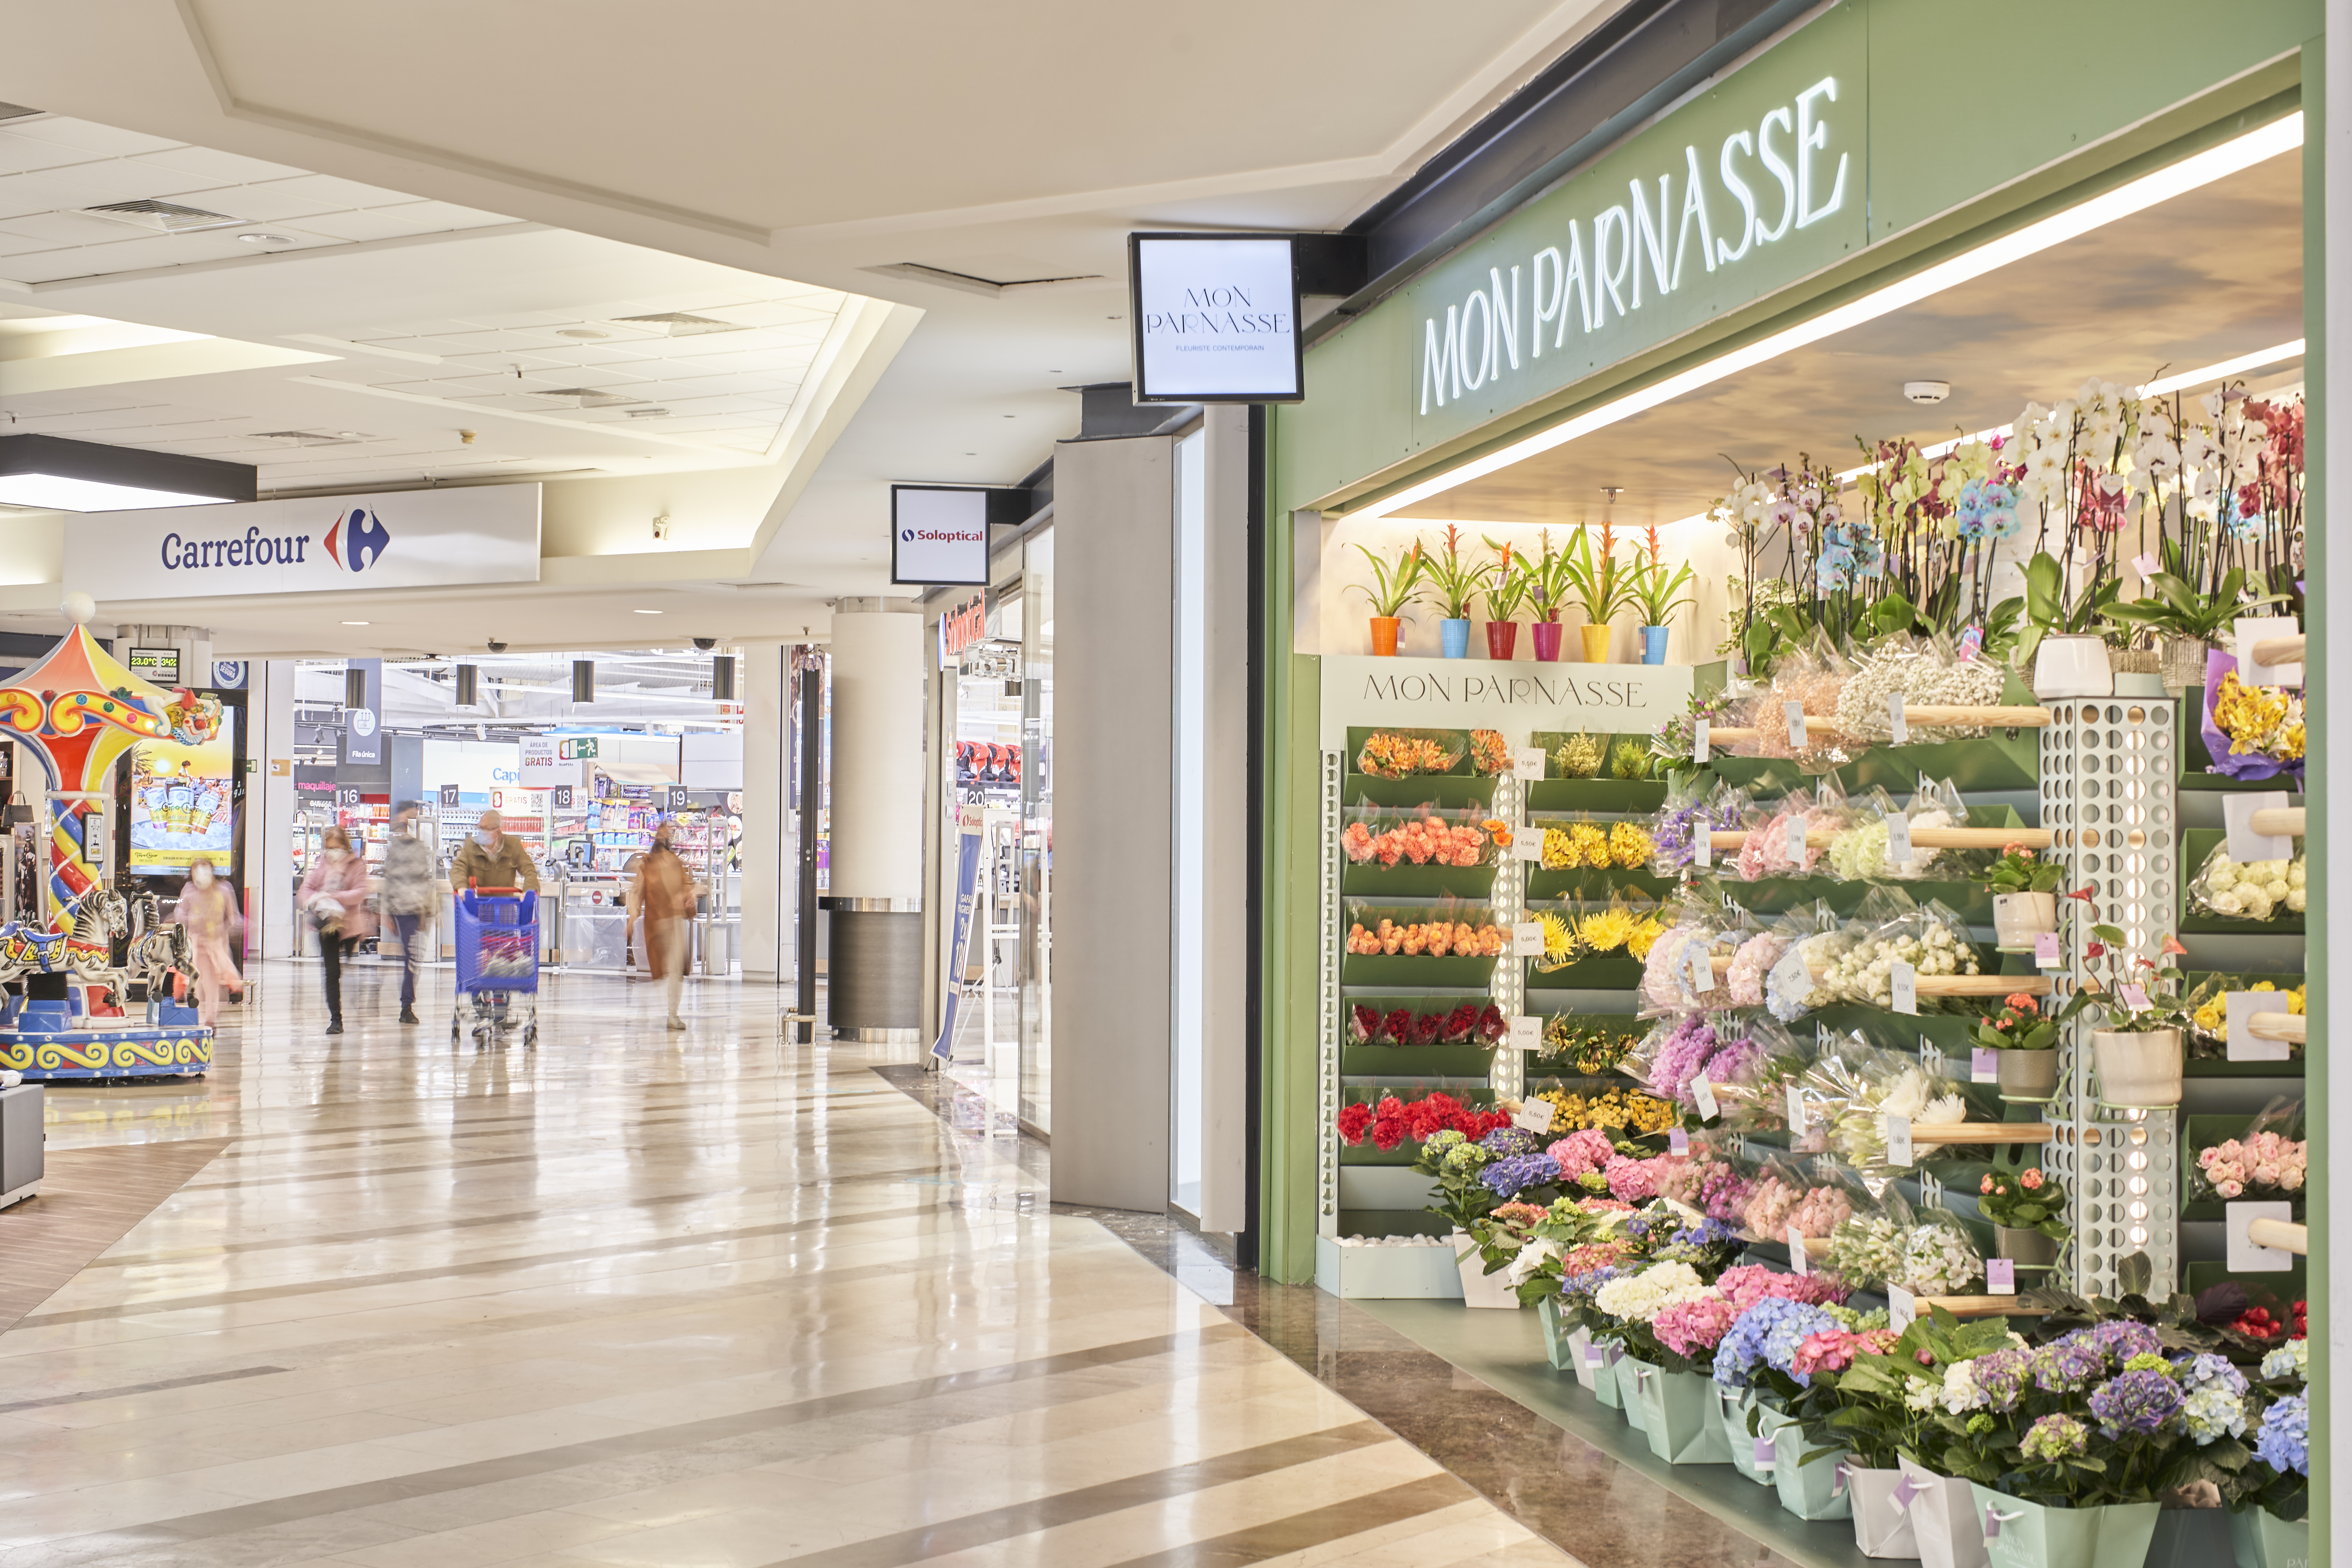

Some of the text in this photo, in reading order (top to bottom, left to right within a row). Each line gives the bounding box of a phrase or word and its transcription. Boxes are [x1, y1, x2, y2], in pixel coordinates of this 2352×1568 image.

[1420, 76, 1848, 416] MON PARNASSE
[1184, 286, 1251, 307] MON
[1147, 312, 1290, 333] PARNASSE
[918, 530, 983, 543] Soloptical
[162, 526, 309, 570] Carrefour
[945, 587, 985, 663] Soloptical
[161, 658, 176, 667] 34%
[220, 665, 235, 679] SEGURA
[1364, 673, 1647, 708] MON PARNASSE
[525, 757, 552, 766] GRATIS
[298, 781, 336, 793] maquillaje
[343, 789, 358, 803] 16
[443, 789, 456, 803] 17
[557, 789, 570, 805] 18
[671, 790, 686, 806] 19
[969, 791, 984, 805] 20
[969, 816, 982, 829] Soloptic
[1528, 1111, 1544, 1120] 5,50€
